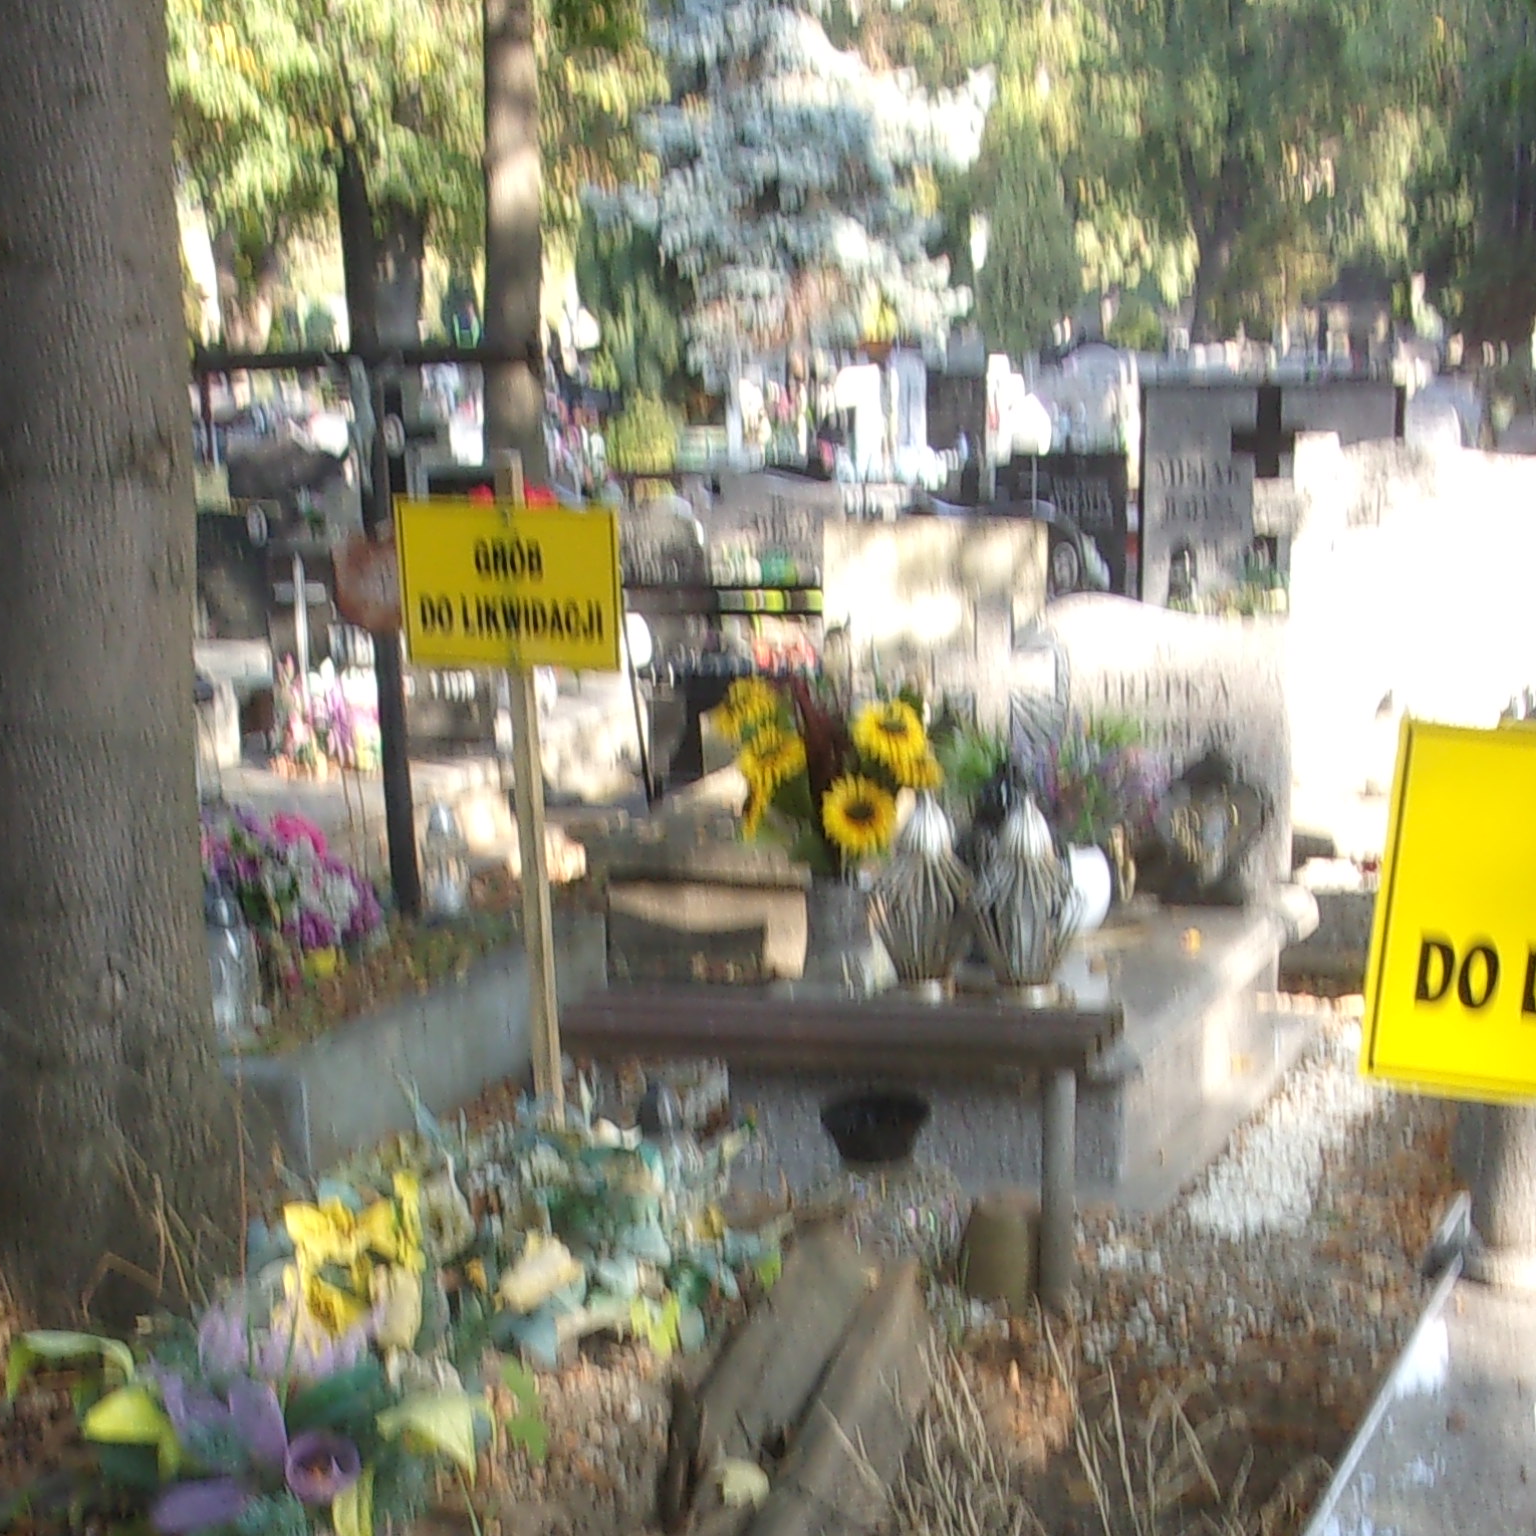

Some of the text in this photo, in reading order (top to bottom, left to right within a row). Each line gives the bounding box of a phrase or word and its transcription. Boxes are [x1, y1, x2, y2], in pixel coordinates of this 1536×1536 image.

[419, 594, 605, 642] DO LIKWIDACJI
[1414, 931, 1502, 1012] DO
